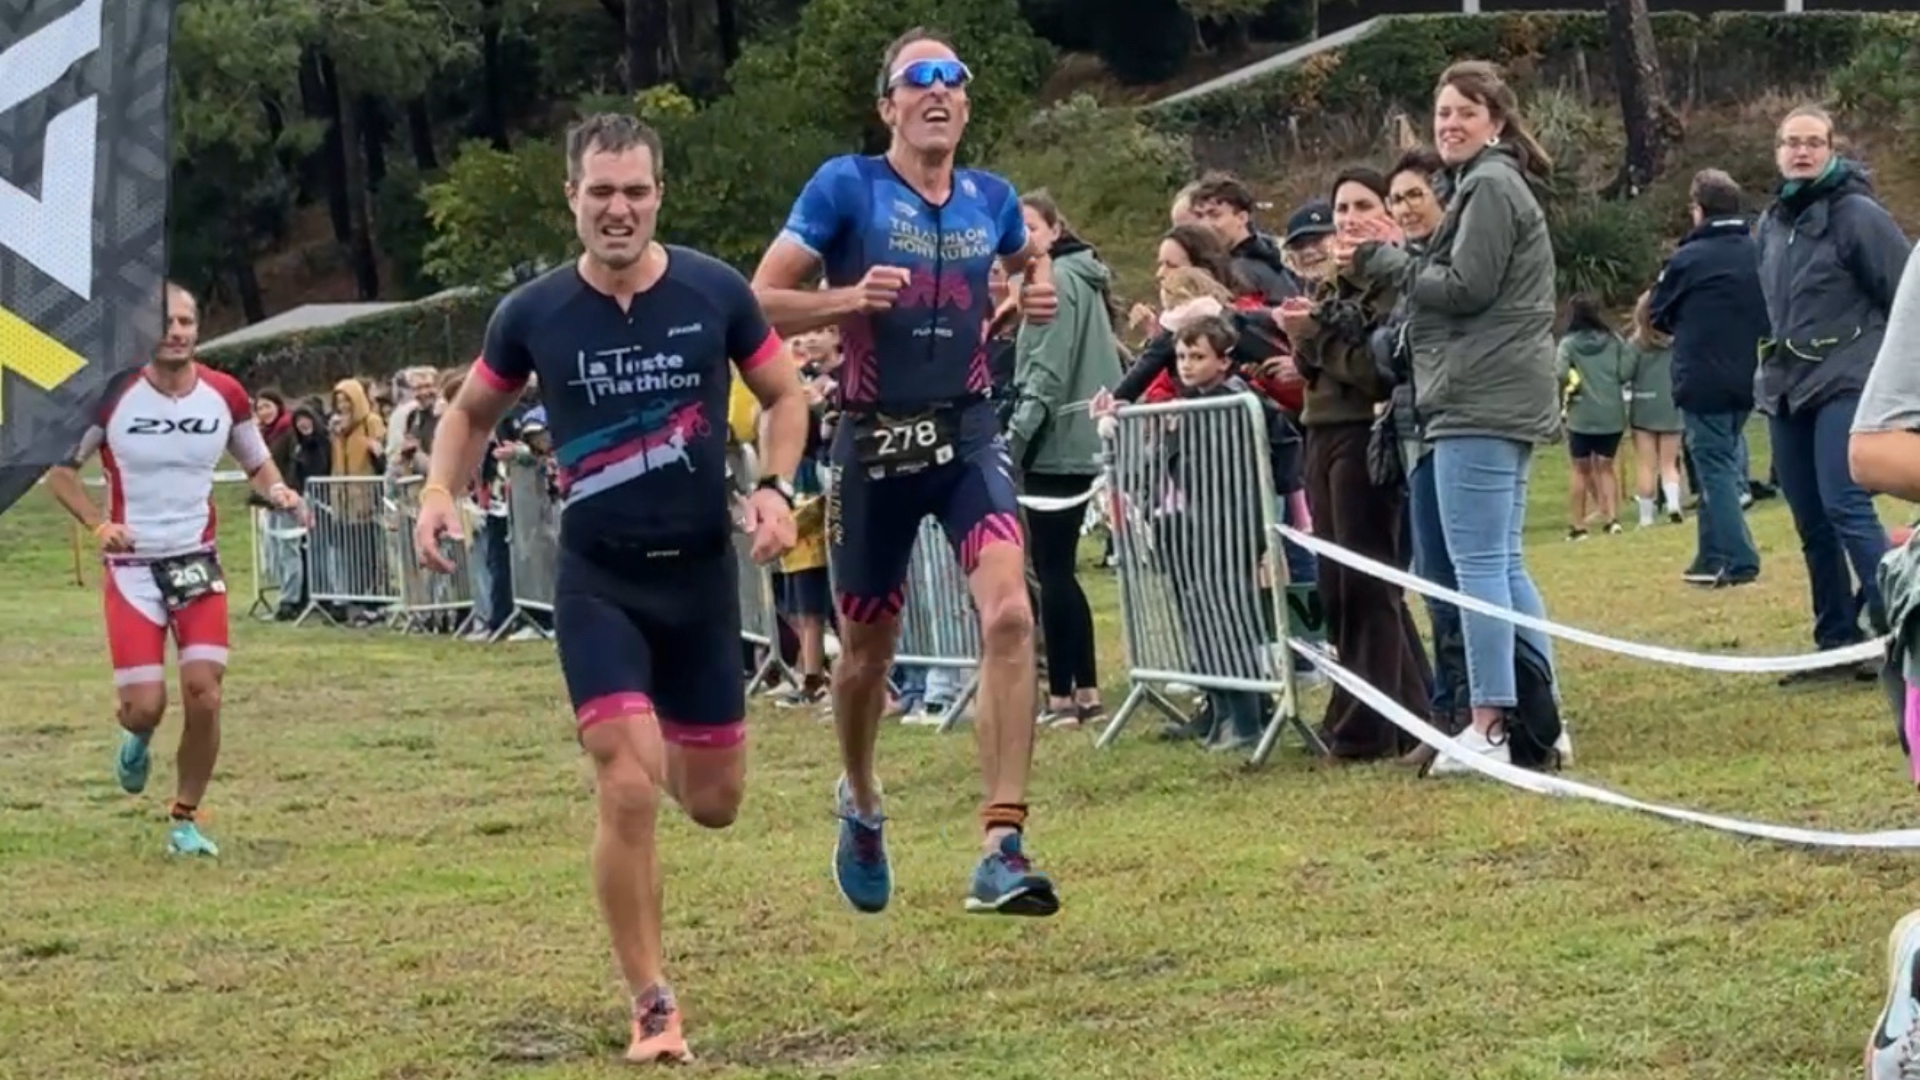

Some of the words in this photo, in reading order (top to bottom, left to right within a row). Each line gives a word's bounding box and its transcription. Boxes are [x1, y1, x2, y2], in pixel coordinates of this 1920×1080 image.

[889, 216, 987, 244] TRIATHLON
[127, 417, 220, 434] 2XU
[873, 421, 937, 456] 278
[169, 562, 209, 588] 261
